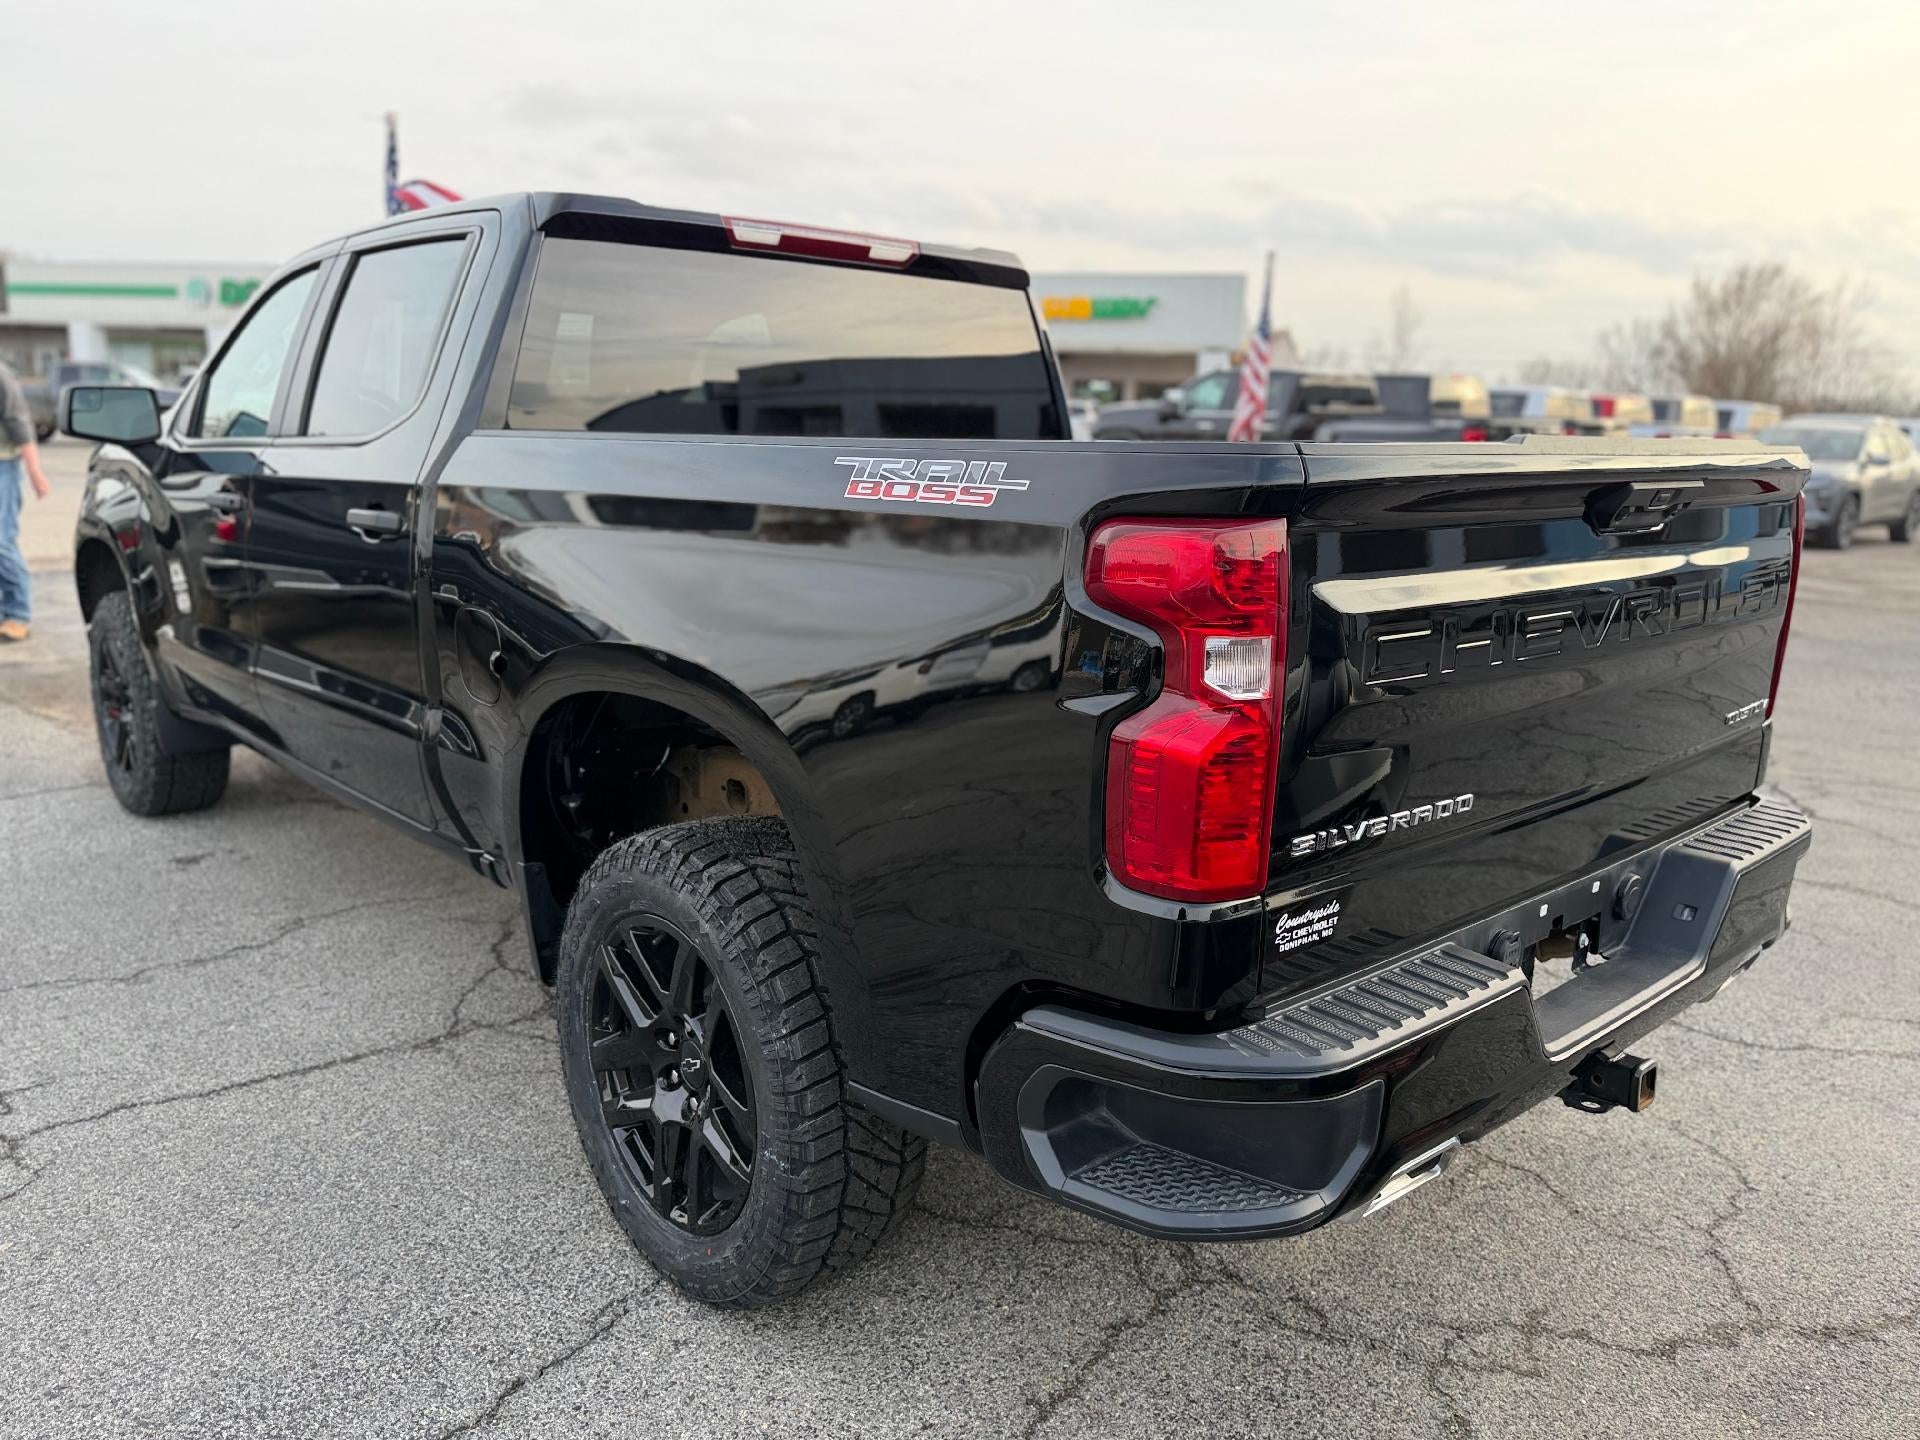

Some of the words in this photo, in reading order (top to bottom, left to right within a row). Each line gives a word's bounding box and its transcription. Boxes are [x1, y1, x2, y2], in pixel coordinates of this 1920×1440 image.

[834, 456, 1030, 490] TRAIL
[844, 479, 999, 507] BOSS
[1361, 569, 1789, 685] CHEVROLET
[1290, 793, 1474, 857] SILVERADO
[1275, 899, 1340, 934] Countryside
[1292, 916, 1338, 939] CHEVROLET
[1279, 932, 1319, 952] DONIPHAN,
[1321, 928, 1334, 938] MO
